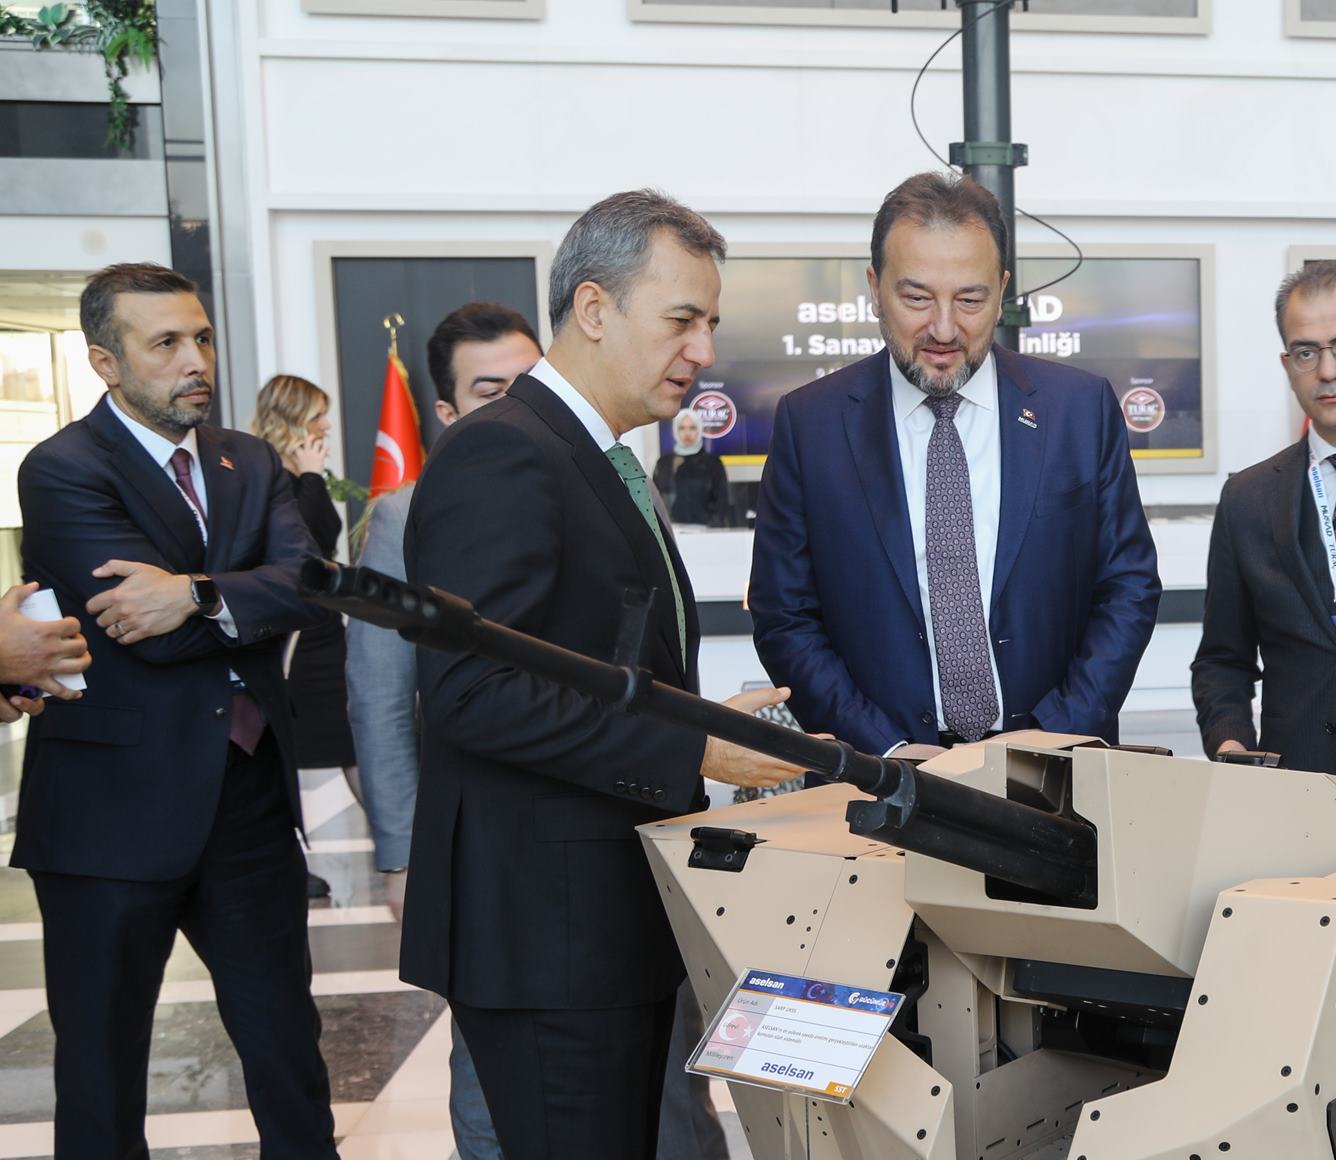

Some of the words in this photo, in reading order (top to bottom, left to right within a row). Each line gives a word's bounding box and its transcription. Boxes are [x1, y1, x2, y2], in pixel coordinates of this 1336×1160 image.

[782, 334, 802, 355] 1.
[1019, 332, 1080, 358] inliği
[749, 977, 785, 990] aselsan
[761, 1062, 814, 1081] aselsan
